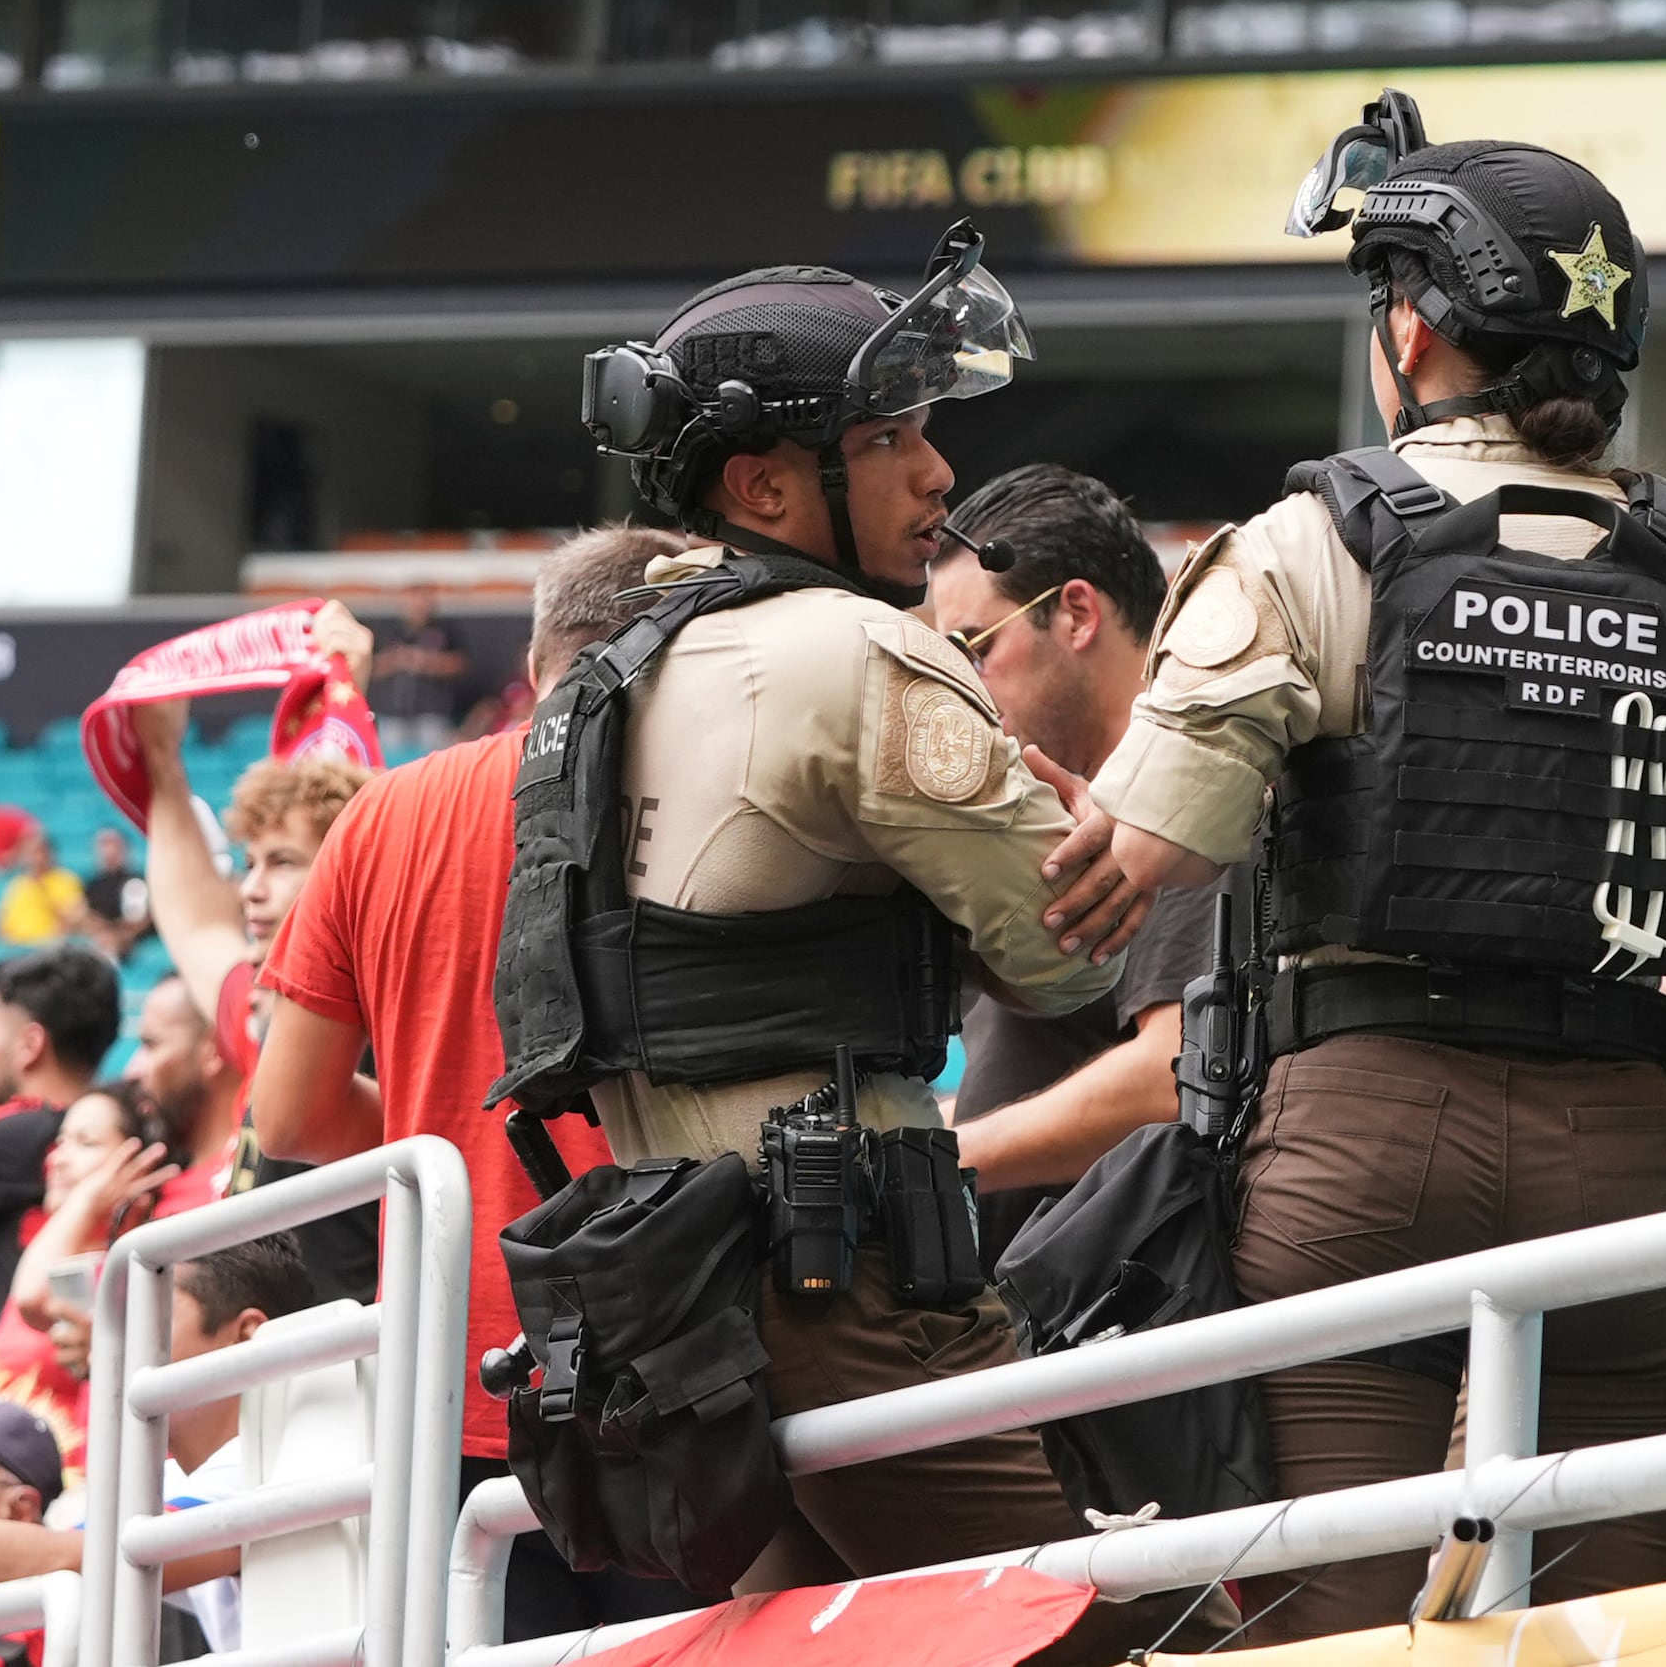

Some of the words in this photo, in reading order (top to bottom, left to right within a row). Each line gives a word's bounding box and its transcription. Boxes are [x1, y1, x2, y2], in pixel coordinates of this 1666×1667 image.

[826, 148, 955, 211] FIFA
[959, 143, 1110, 207] CLUB
[1453, 590, 1660, 655] POLICE
